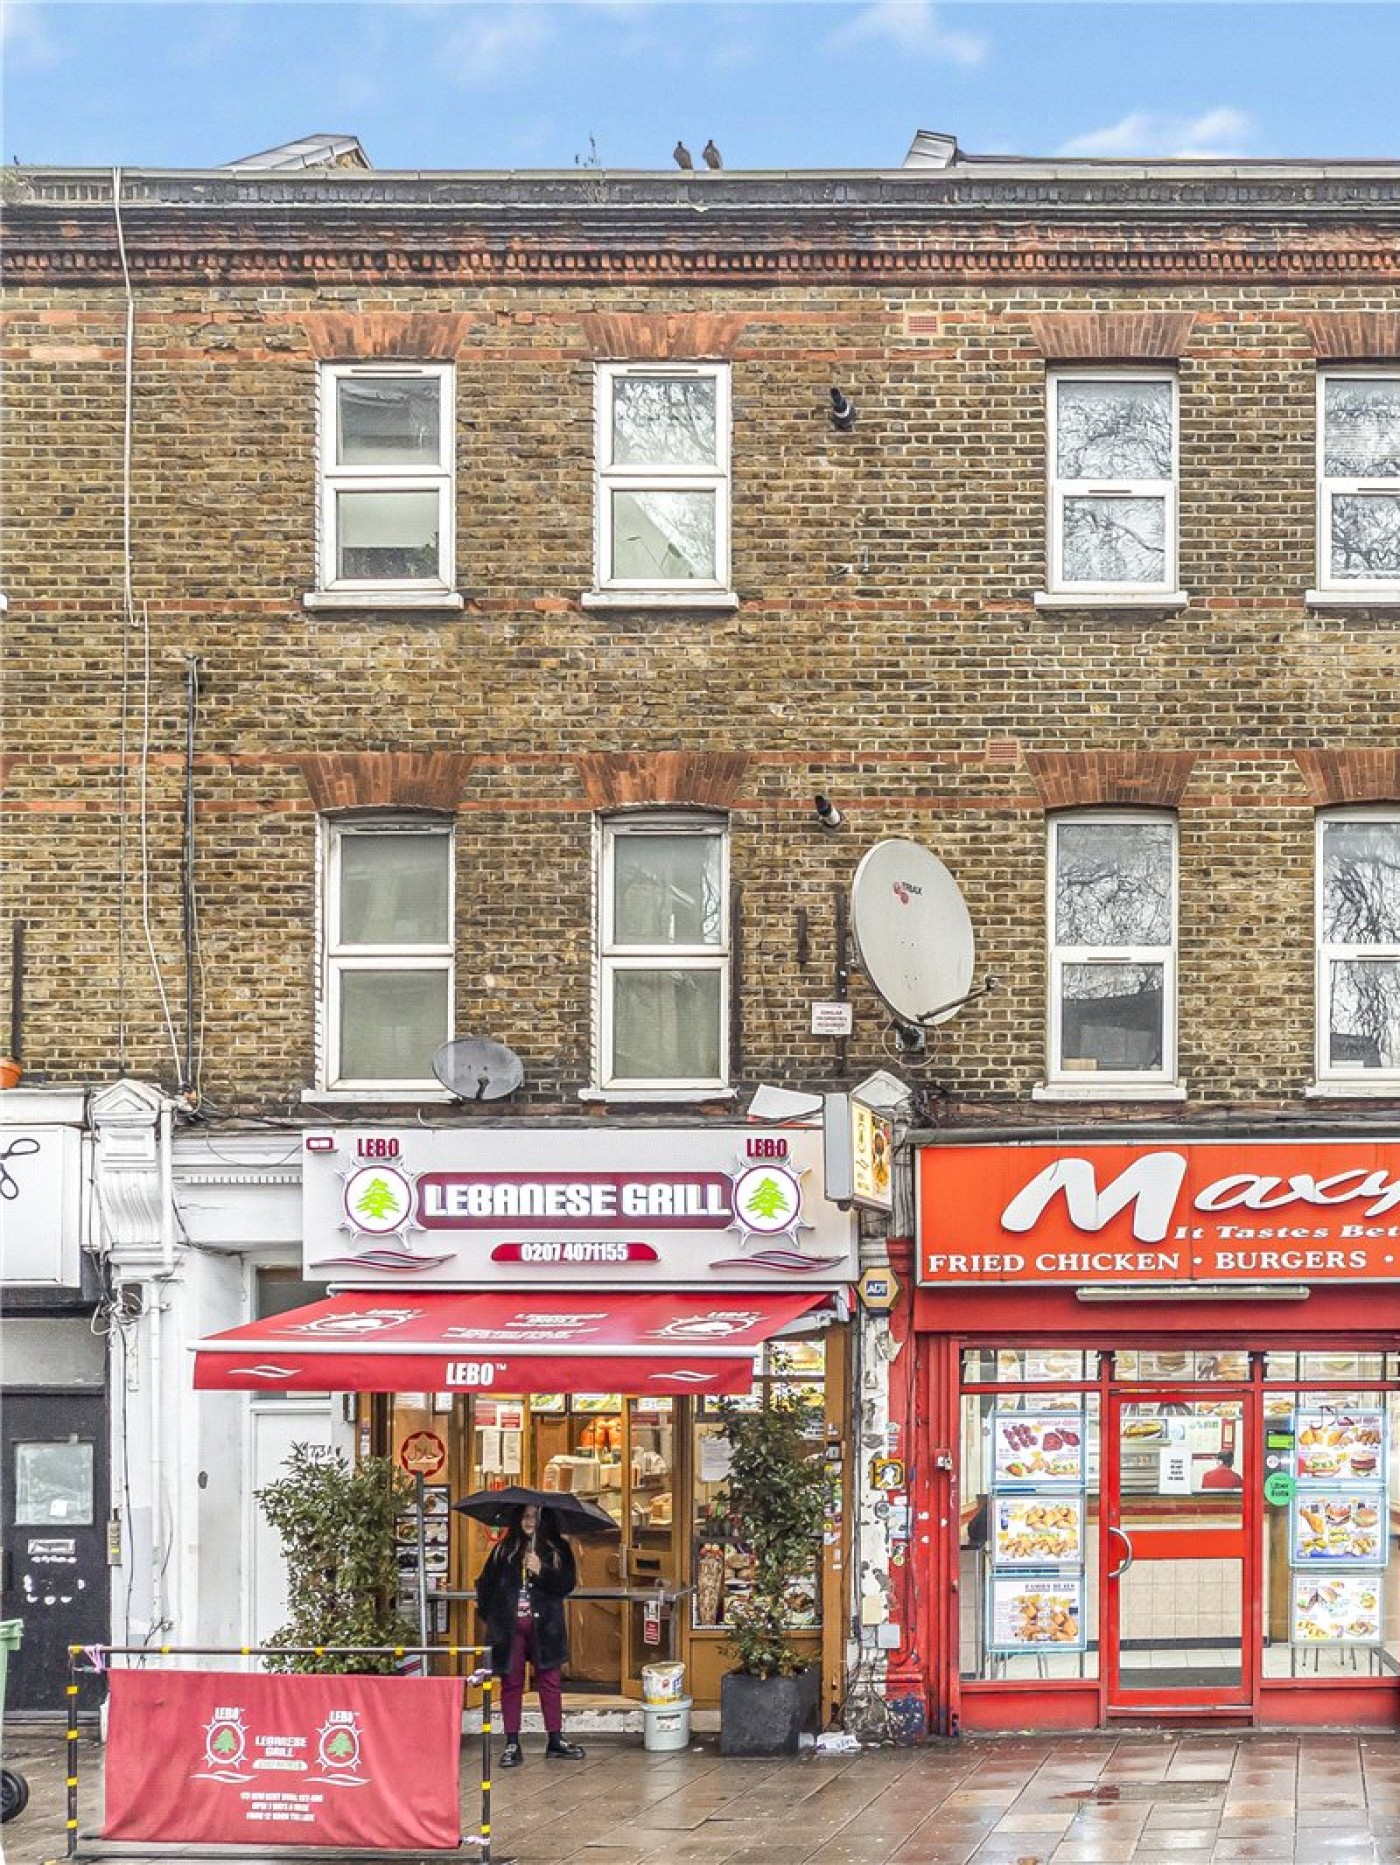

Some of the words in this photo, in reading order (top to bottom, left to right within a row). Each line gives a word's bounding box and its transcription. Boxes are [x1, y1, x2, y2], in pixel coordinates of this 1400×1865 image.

[357, 1138, 400, 1157] LEBO
[746, 1138, 788, 1157] LEBO
[424, 1183, 617, 1217] LEBANESE
[622, 1183, 732, 1217] GRILL
[1174, 1225, 1204, 1240] It
[1216, 1225, 1330, 1239] Tastes
[521, 1243, 561, 1261] 0207
[563, 1243, 628, 1261] 4071155
[928, 1253, 1024, 1272] FRIED
[1035, 1252, 1179, 1272] CHICKEN
[1215, 1250, 1368, 1270] BURGERS
[867, 1283, 888, 1294] ADT
